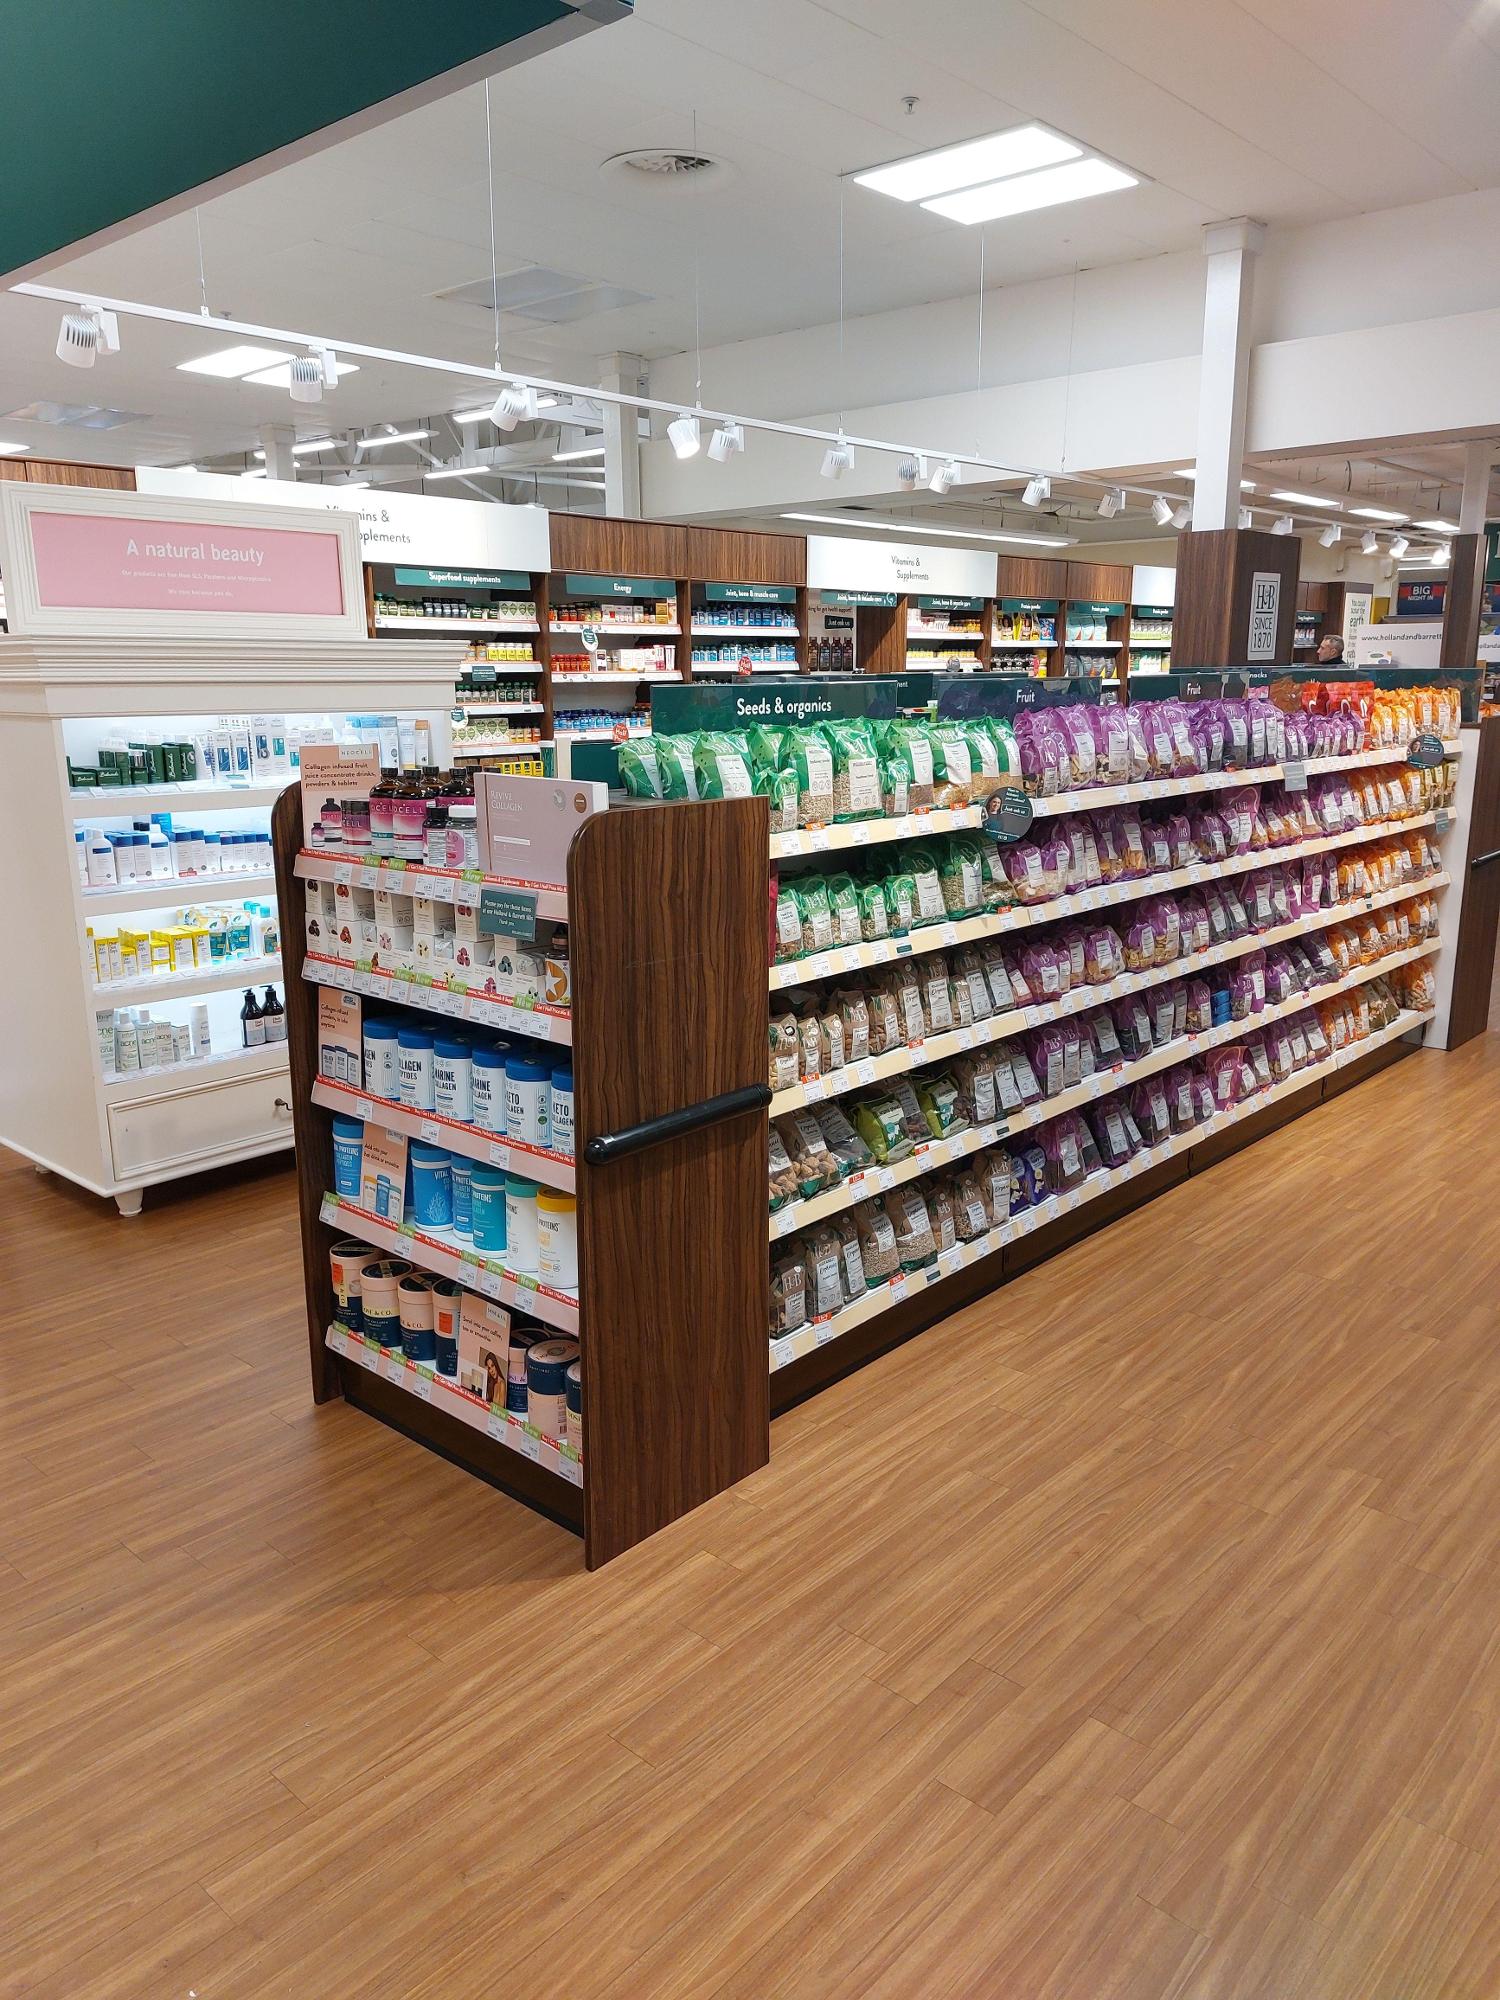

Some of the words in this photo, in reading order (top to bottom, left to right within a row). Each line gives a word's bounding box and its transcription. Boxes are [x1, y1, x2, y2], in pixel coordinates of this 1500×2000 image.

[381, 510, 390, 522] &
[127, 539, 139, 556] A
[145, 542, 205, 560] natural
[211, 544, 264, 567] beauty
[891, 555, 915, 567] Vitamins
[916, 557, 921, 567] &
[429, 571, 462, 583] Superfood
[463, 575, 501, 585] supplements
[896, 570, 929, 581] Supplements
[614, 583, 632, 594] Energy
[1413, 585, 1430, 595] BIG
[1254, 617, 1273, 630] SINCE
[1252, 632, 1272, 649] 1870
[1250, 671, 1267, 679] nacks
[1016, 689, 1035, 704] Fruit
[737, 698, 771, 715] Seeds
[775, 698, 784, 714] &
[787, 698, 832, 719] organics
[305, 763, 331, 771] Collagen
[305, 772, 318, 780] juice
